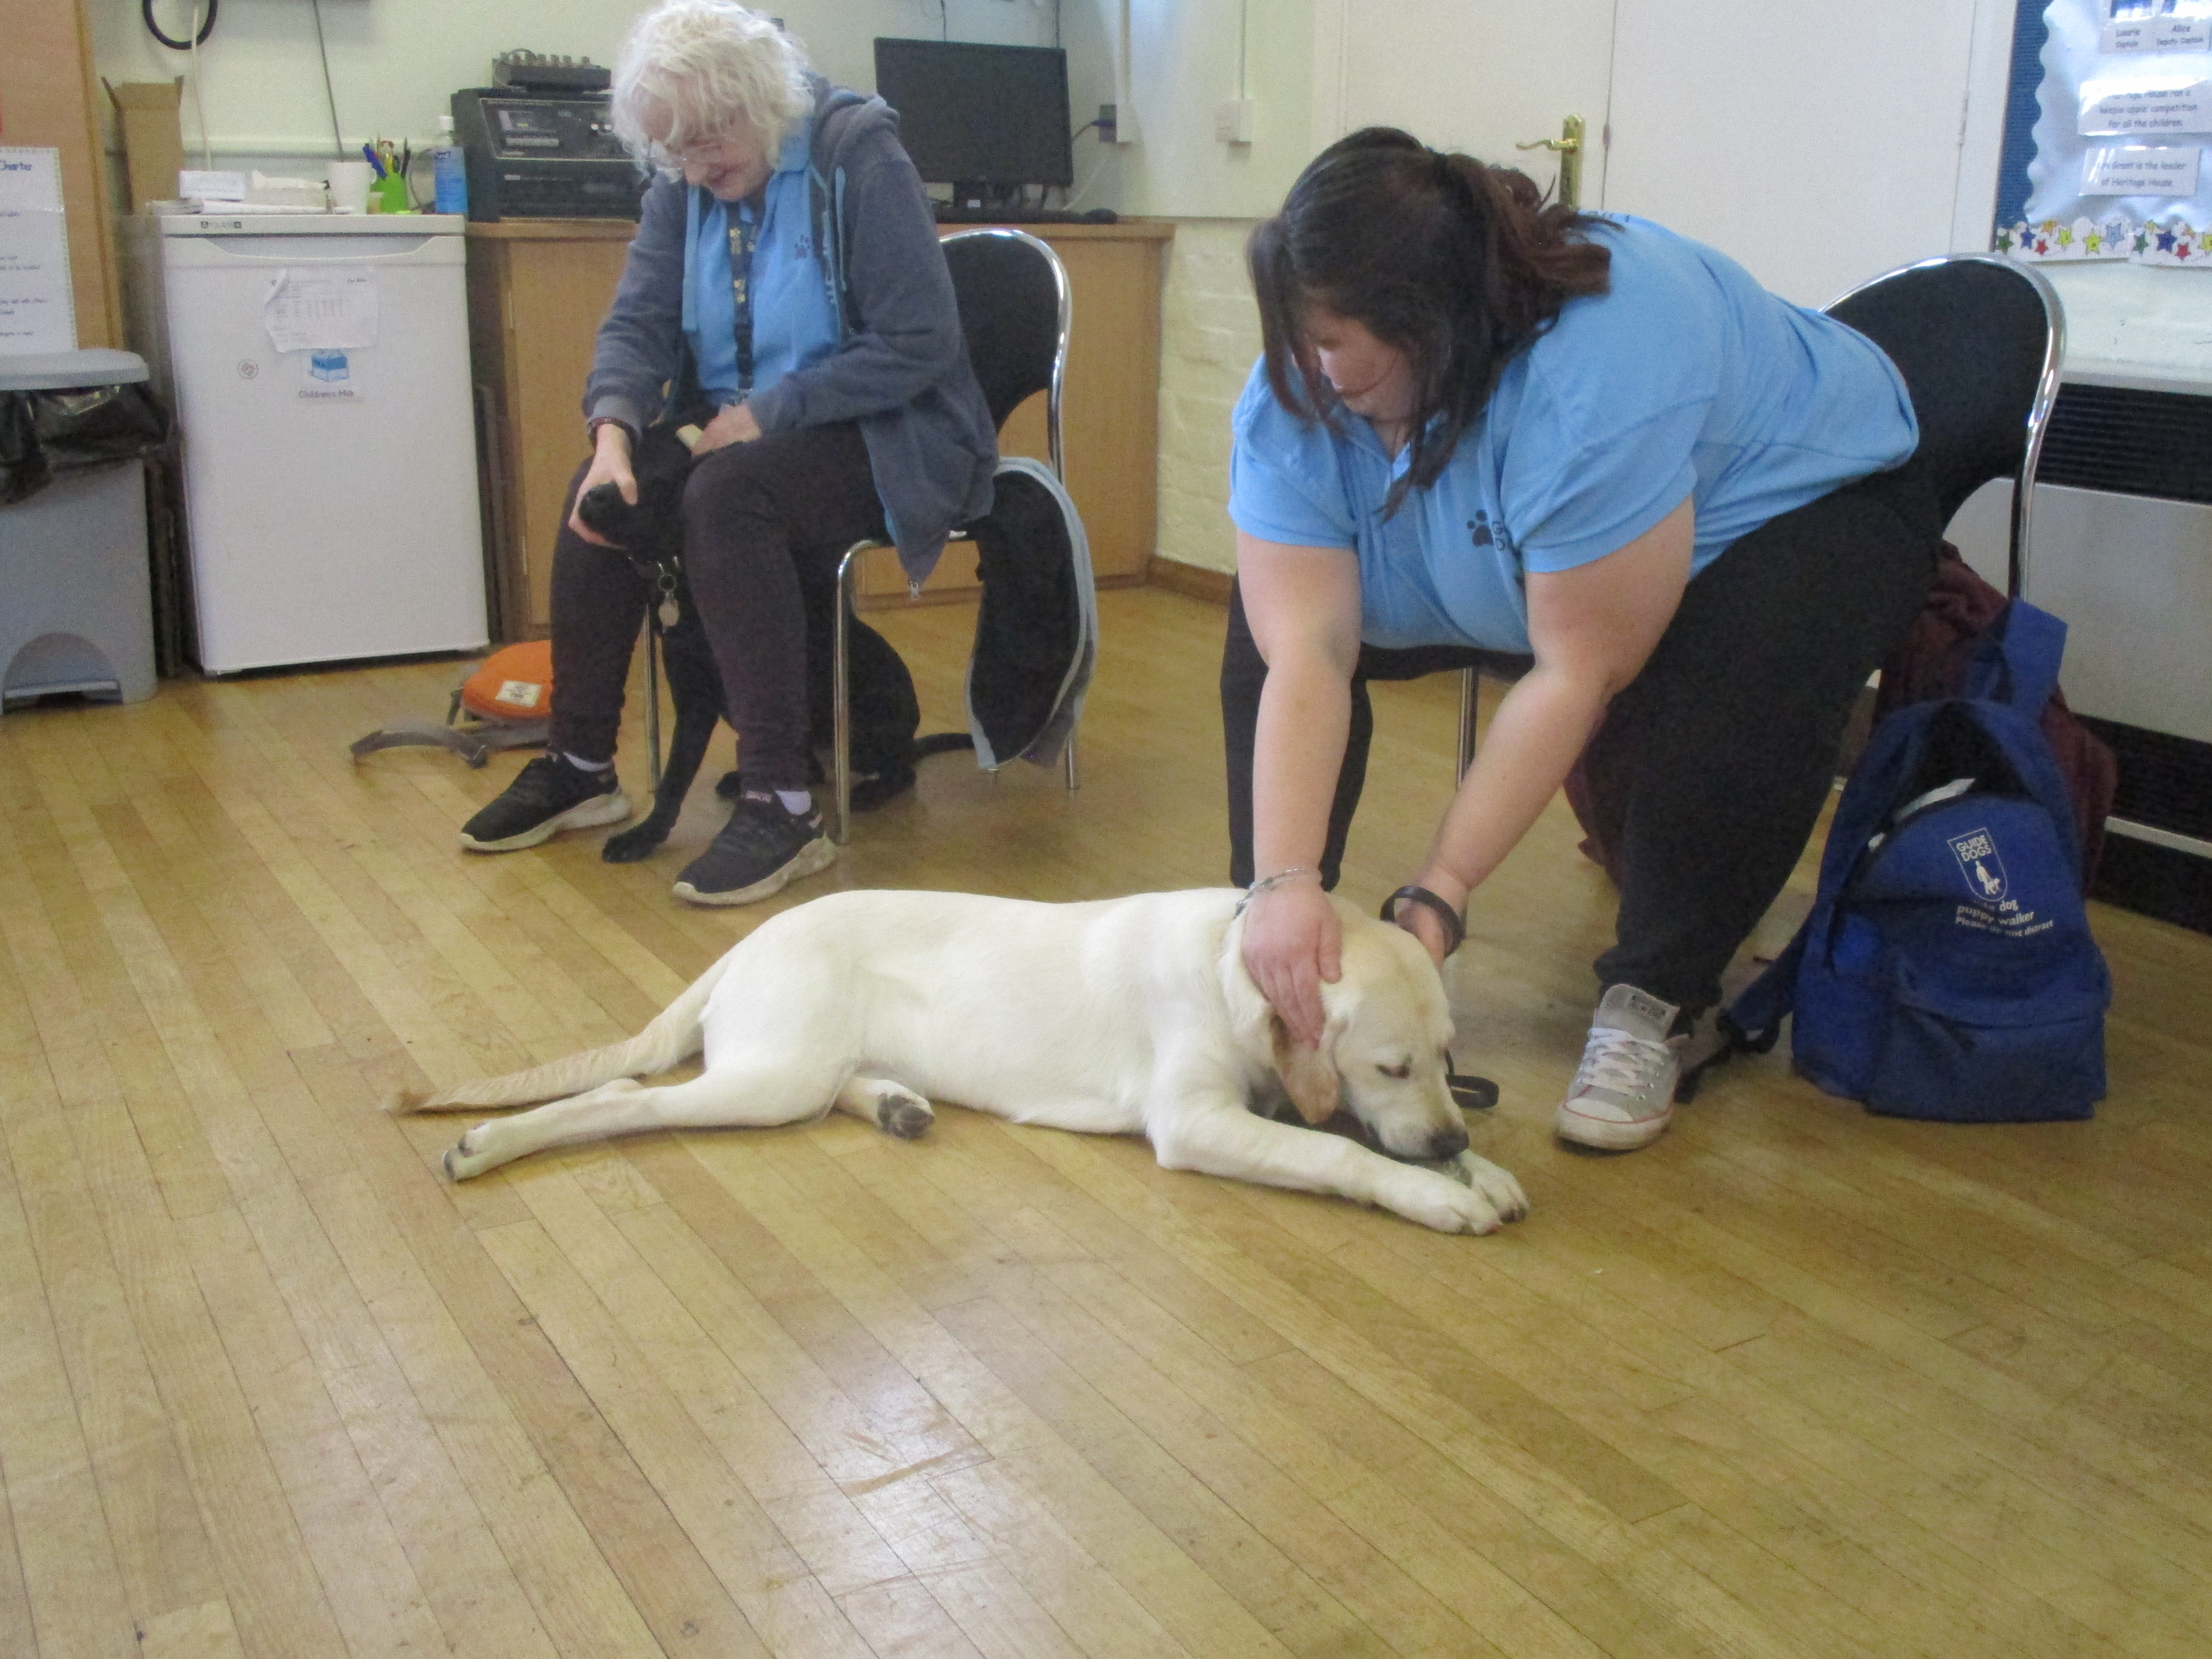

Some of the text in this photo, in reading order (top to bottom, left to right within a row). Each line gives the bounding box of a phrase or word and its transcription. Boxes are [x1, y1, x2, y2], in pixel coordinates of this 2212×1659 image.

[2150, 104, 2197, 114] competition
[2108, 120, 2120, 128] for
[2134, 119, 2147, 127] the
[2145, 161, 2158, 170] the
[2101, 177, 2110, 186] of
[2148, 178, 2172, 187] House
[1956, 834, 1988, 852] GUIDE
[1960, 844, 1992, 862] DOGS
[1999, 899, 2019, 912] dog
[1998, 911, 2035, 926] walker
